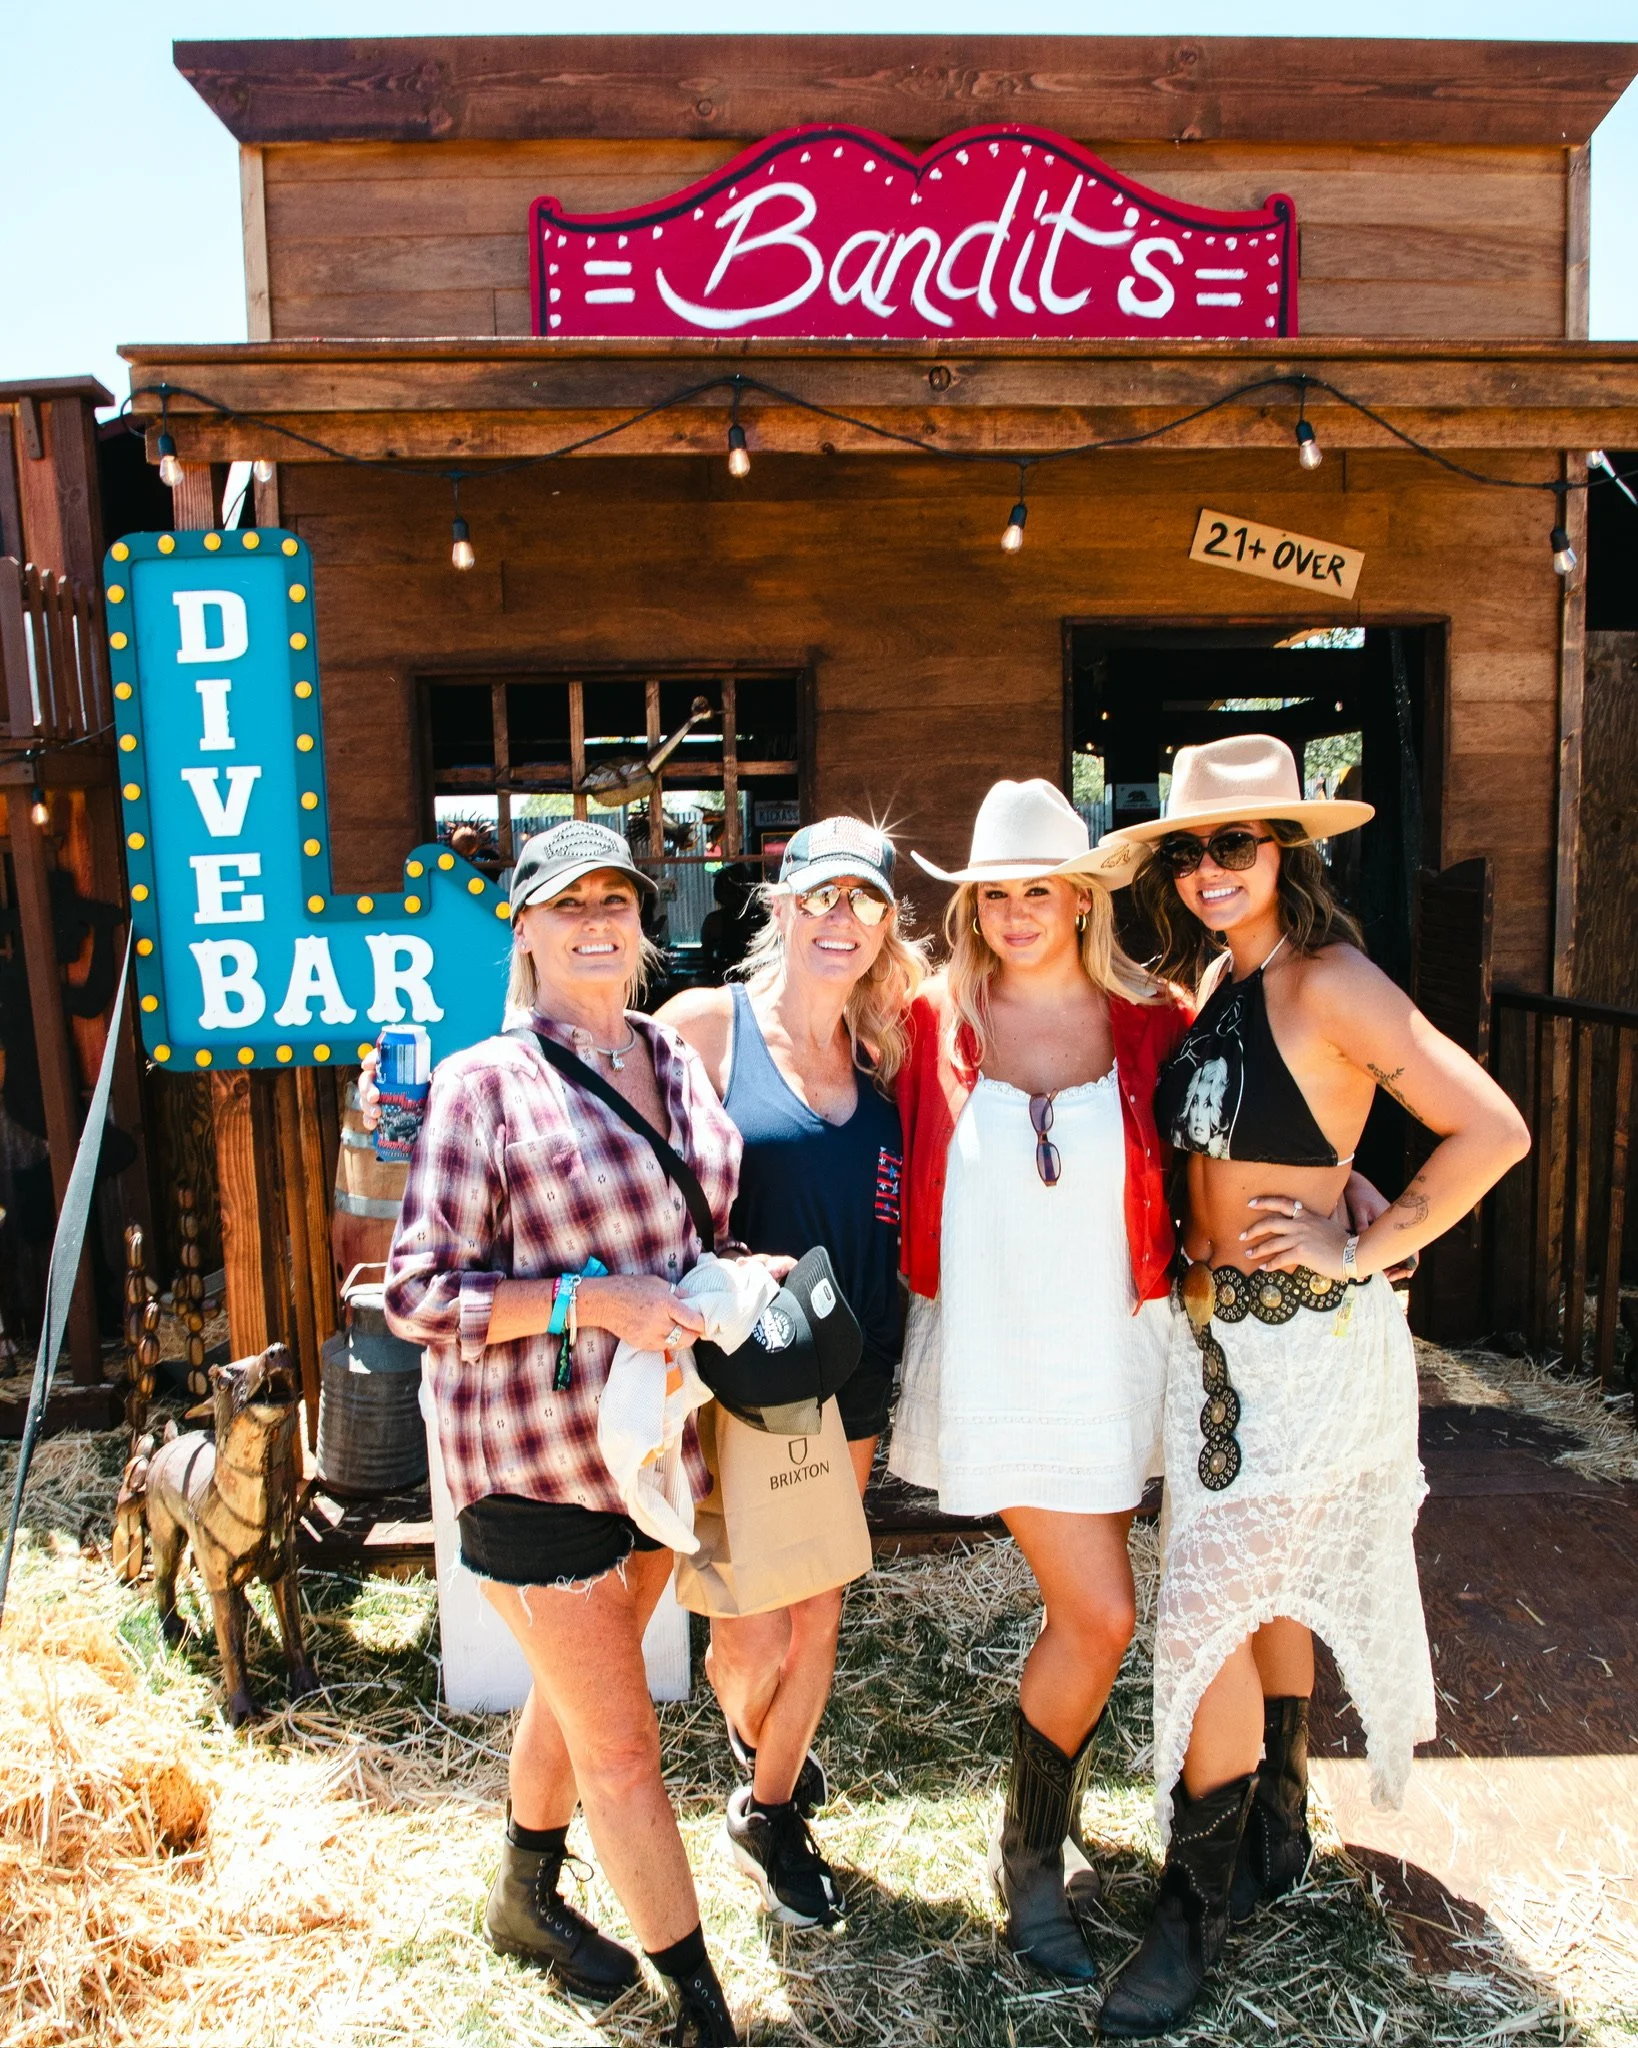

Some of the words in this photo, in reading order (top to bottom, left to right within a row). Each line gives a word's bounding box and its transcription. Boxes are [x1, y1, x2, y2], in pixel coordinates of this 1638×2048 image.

[656, 167, 1184, 328] Bandit's
[1203, 522, 1266, 562] 21+
[1272, 541, 1345, 587] OVER
[172, 590, 265, 925] DIVE
[188, 932, 445, 1030] BAR
[769, 1460, 830, 1491] BRIXTON
